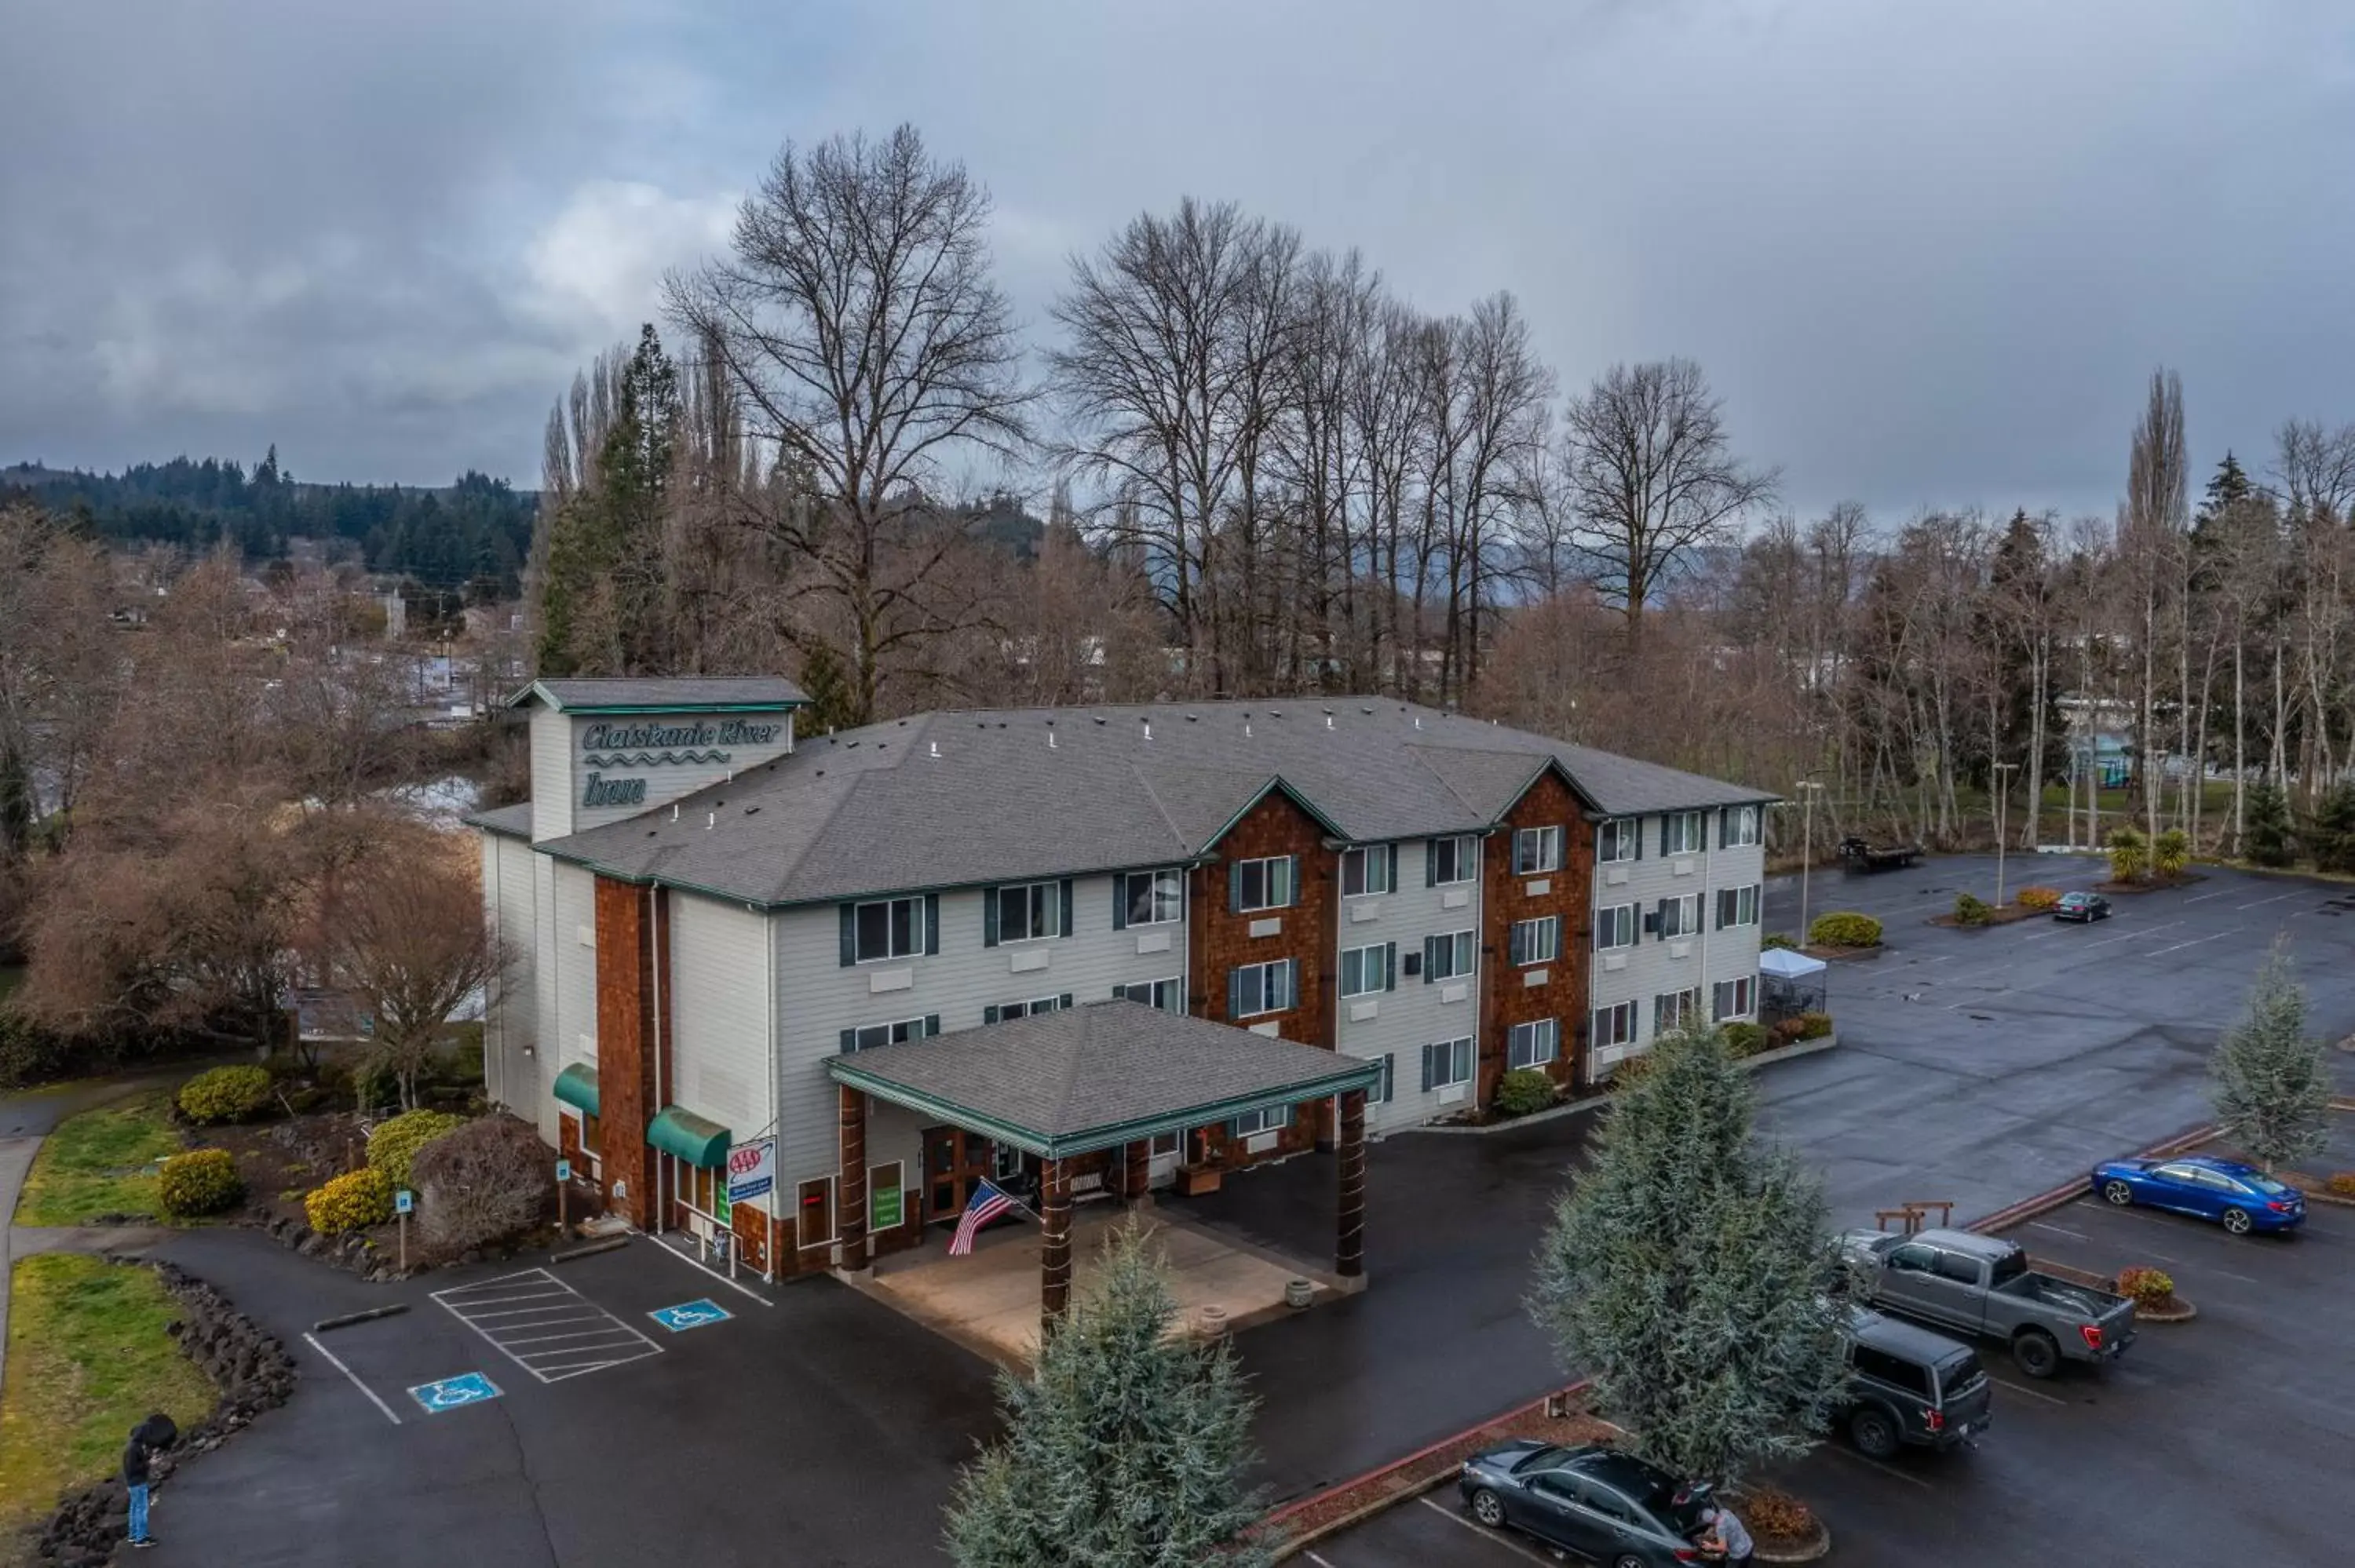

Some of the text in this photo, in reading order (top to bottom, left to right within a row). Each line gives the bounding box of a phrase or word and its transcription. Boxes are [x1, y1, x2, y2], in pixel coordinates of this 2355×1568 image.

[583, 718, 782, 749] Clatskanie River
[583, 771, 646, 807] Inn
[730, 1149, 761, 1174] AAA
